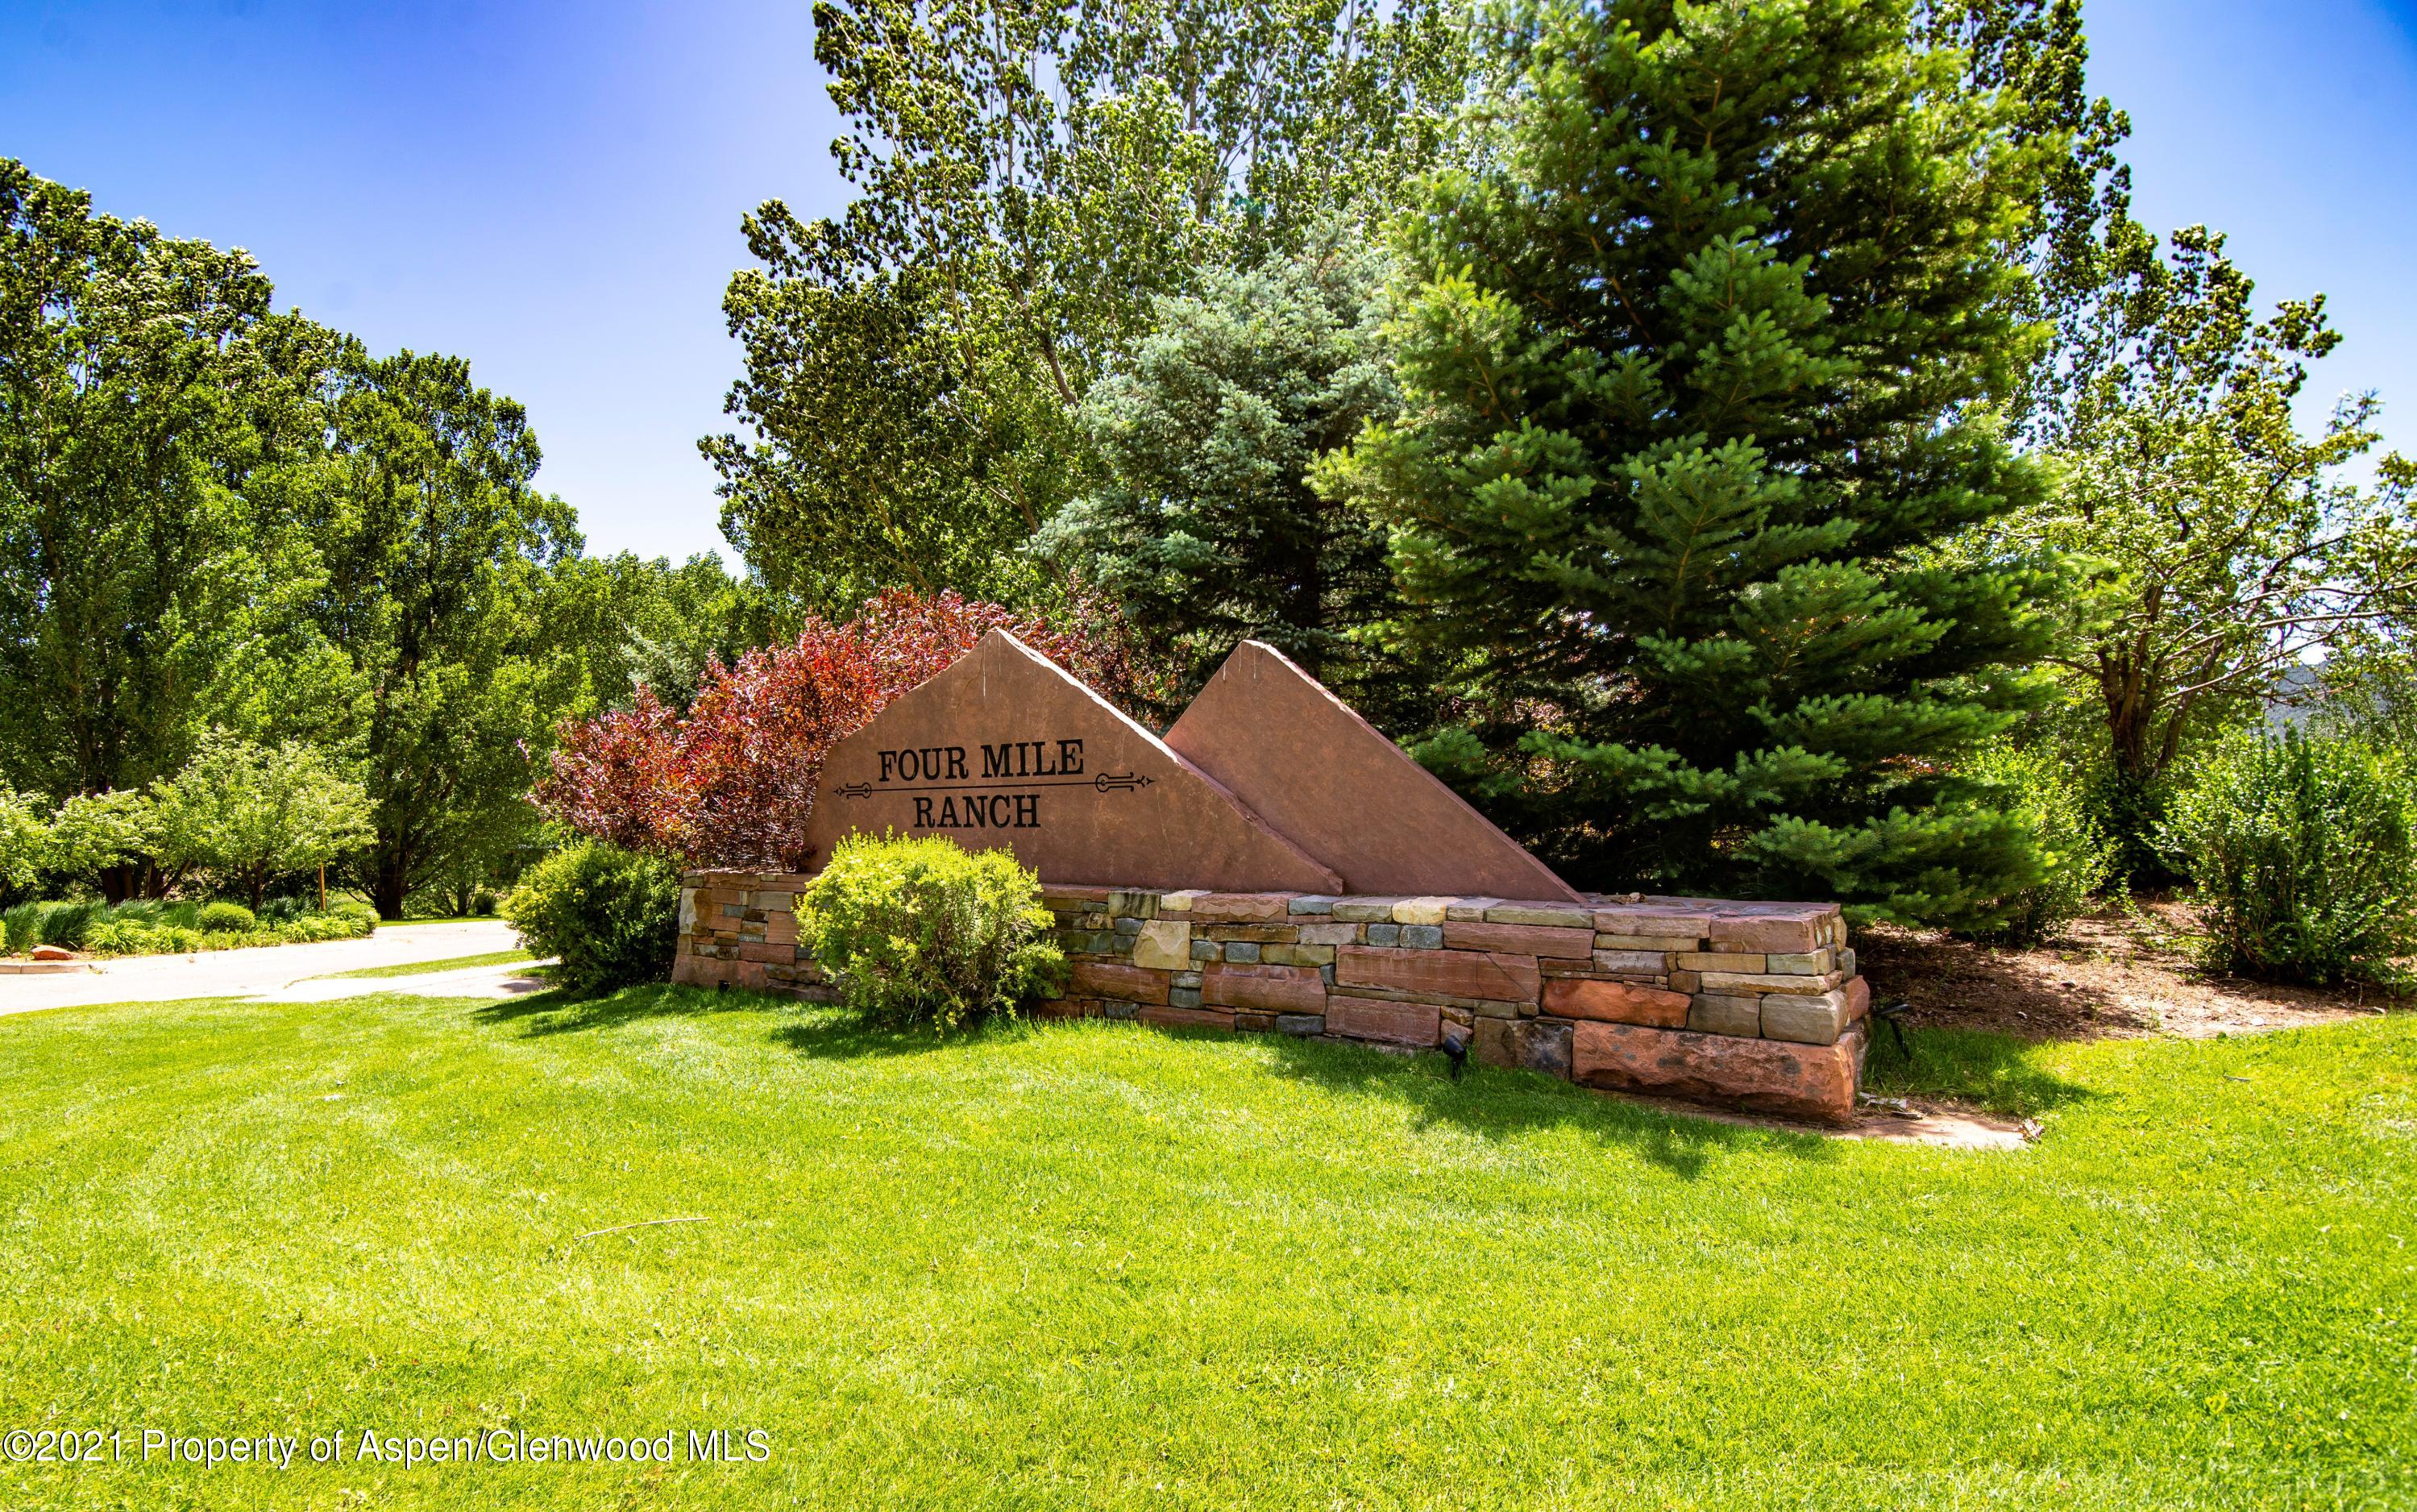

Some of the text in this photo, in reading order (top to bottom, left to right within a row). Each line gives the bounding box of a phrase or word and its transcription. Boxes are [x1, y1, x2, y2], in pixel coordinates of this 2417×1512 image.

[878, 739, 1084, 782] FOUR MILE
[913, 794, 1041, 829] RANCH
